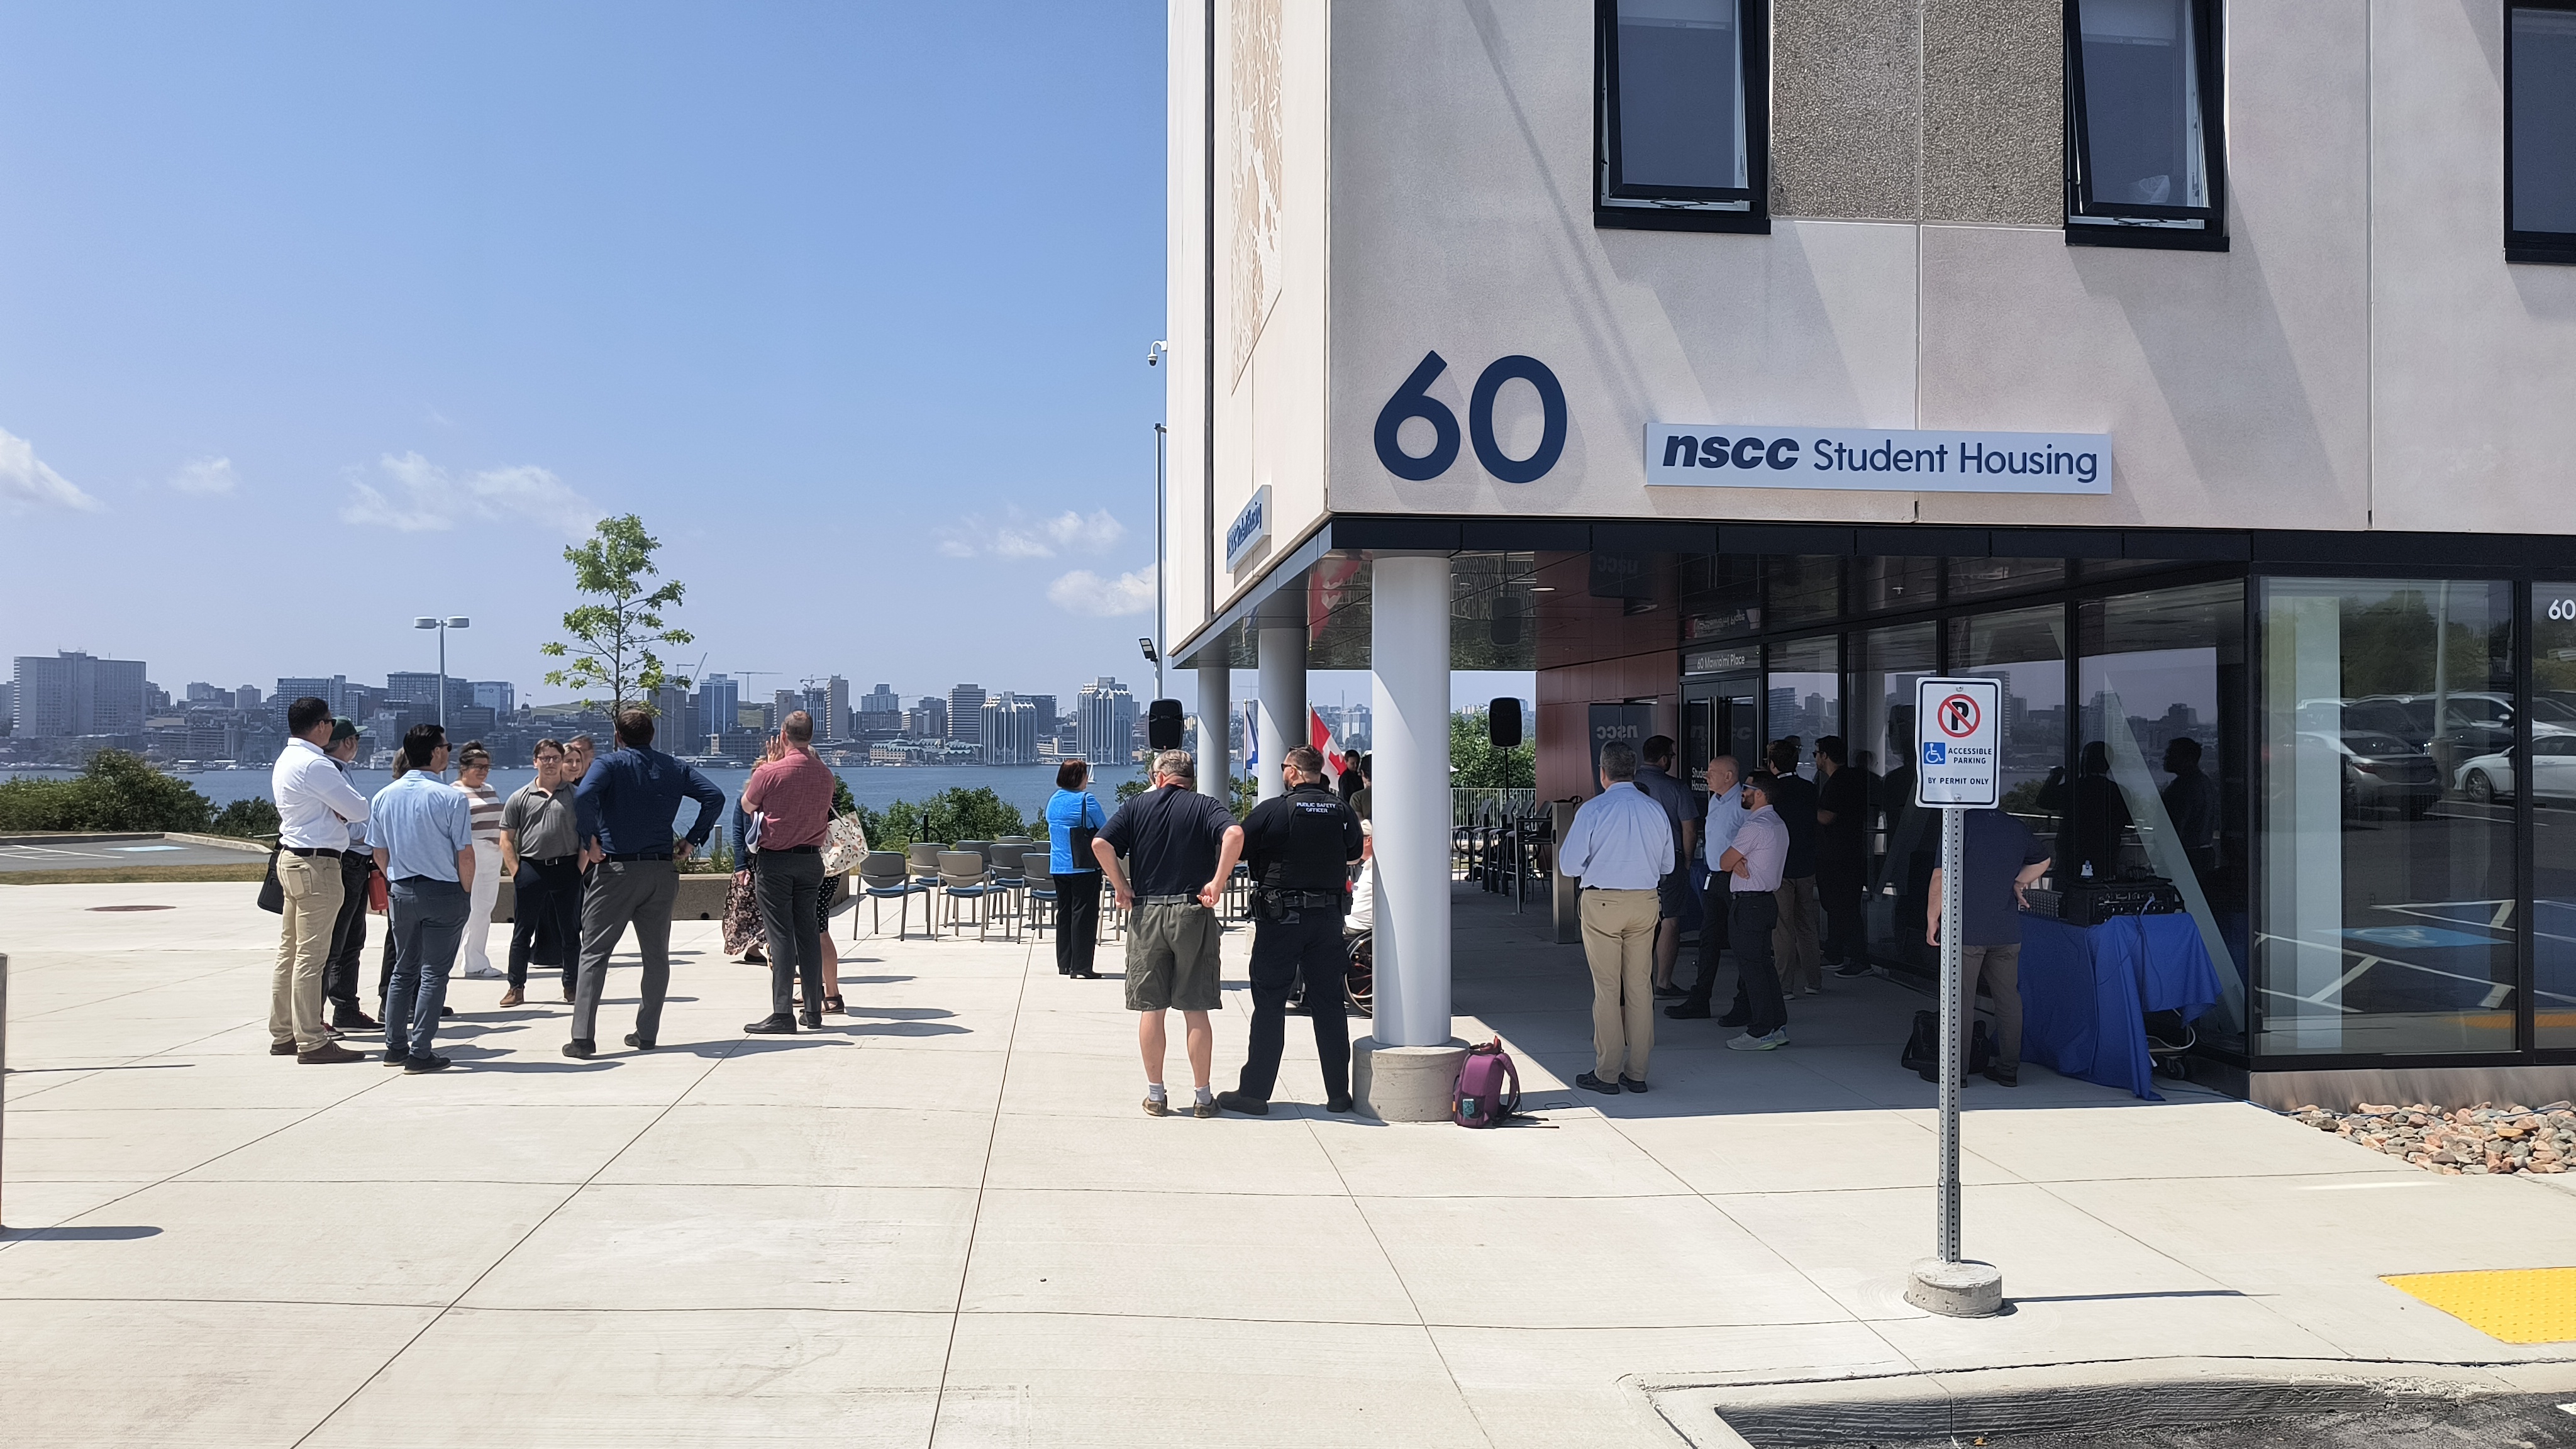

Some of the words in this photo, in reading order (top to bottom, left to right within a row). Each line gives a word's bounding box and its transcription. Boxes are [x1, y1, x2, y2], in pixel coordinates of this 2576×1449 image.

[1374, 350, 1567, 484] 60
[1663, 435, 1800, 470] nscc
[1813, 438, 1948, 472] Student
[1960, 442, 2097, 484] Housing
[2548, 599, 2576, 620] 60
[1697, 658, 1704, 669] 60
[1730, 653, 1745, 665] Place
[1692, 780, 1709, 791] Housin
